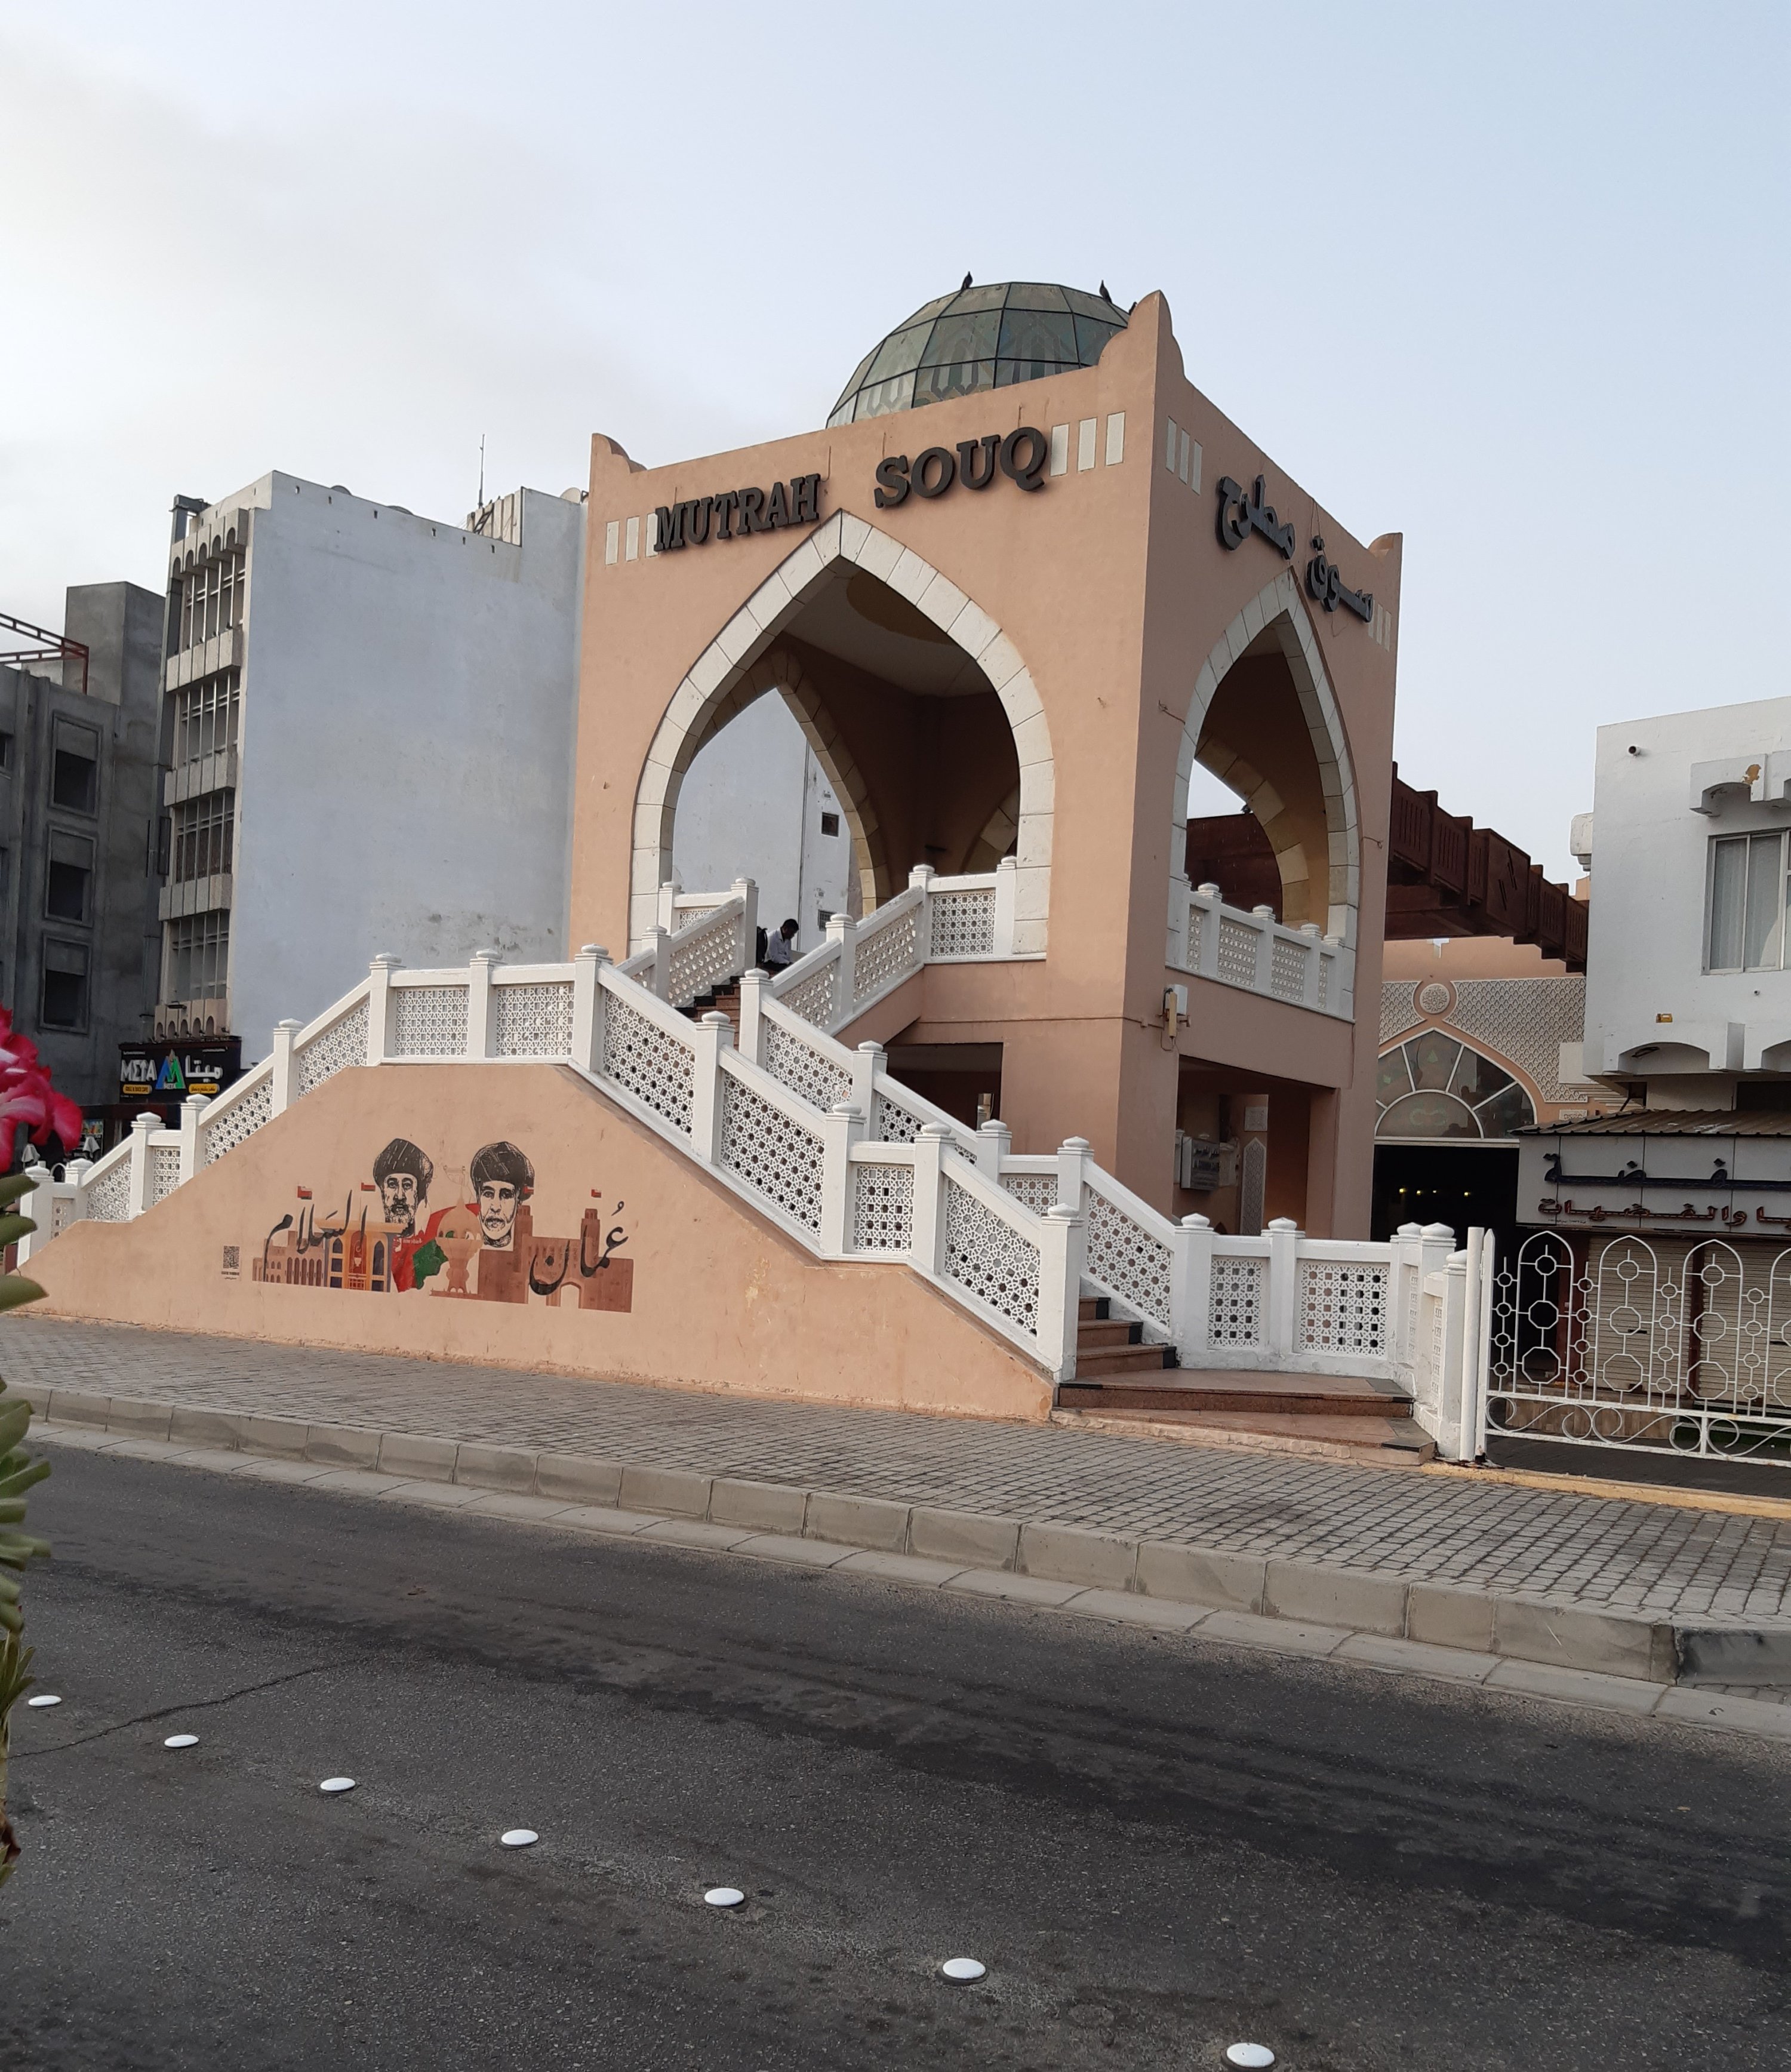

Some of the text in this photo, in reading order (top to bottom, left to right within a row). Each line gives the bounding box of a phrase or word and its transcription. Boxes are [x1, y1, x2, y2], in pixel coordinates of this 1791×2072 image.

[654, 426, 1048, 552] MUTRAH SOUQ
[1215, 474, 1373, 623] سوق مطرح
[120, 1059, 158, 1082] META
[185, 1055, 223, 1083] ميتا
